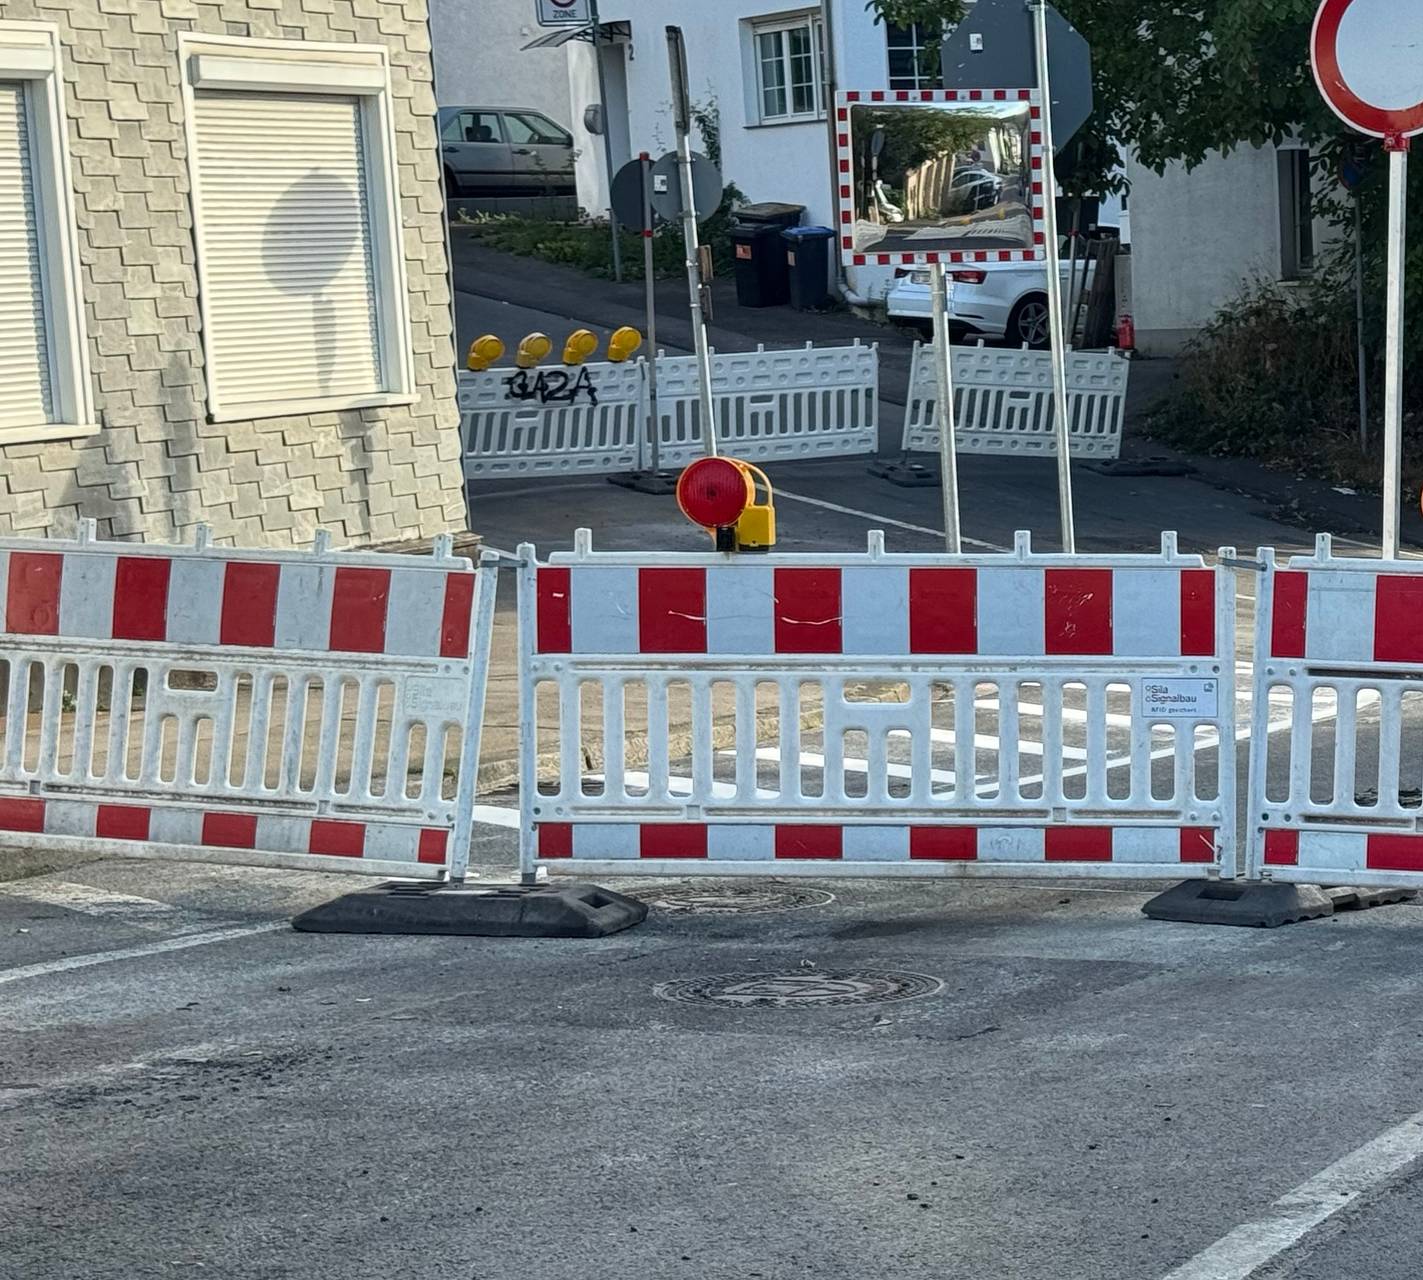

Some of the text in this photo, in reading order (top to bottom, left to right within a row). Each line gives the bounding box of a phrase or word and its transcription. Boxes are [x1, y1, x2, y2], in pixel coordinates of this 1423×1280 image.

[553, 9, 577, 19] ZONE
[628, 44, 634, 61] 2
[1151, 685, 1168, 694] Sila
[1151, 694, 1197, 705] Signalbau
